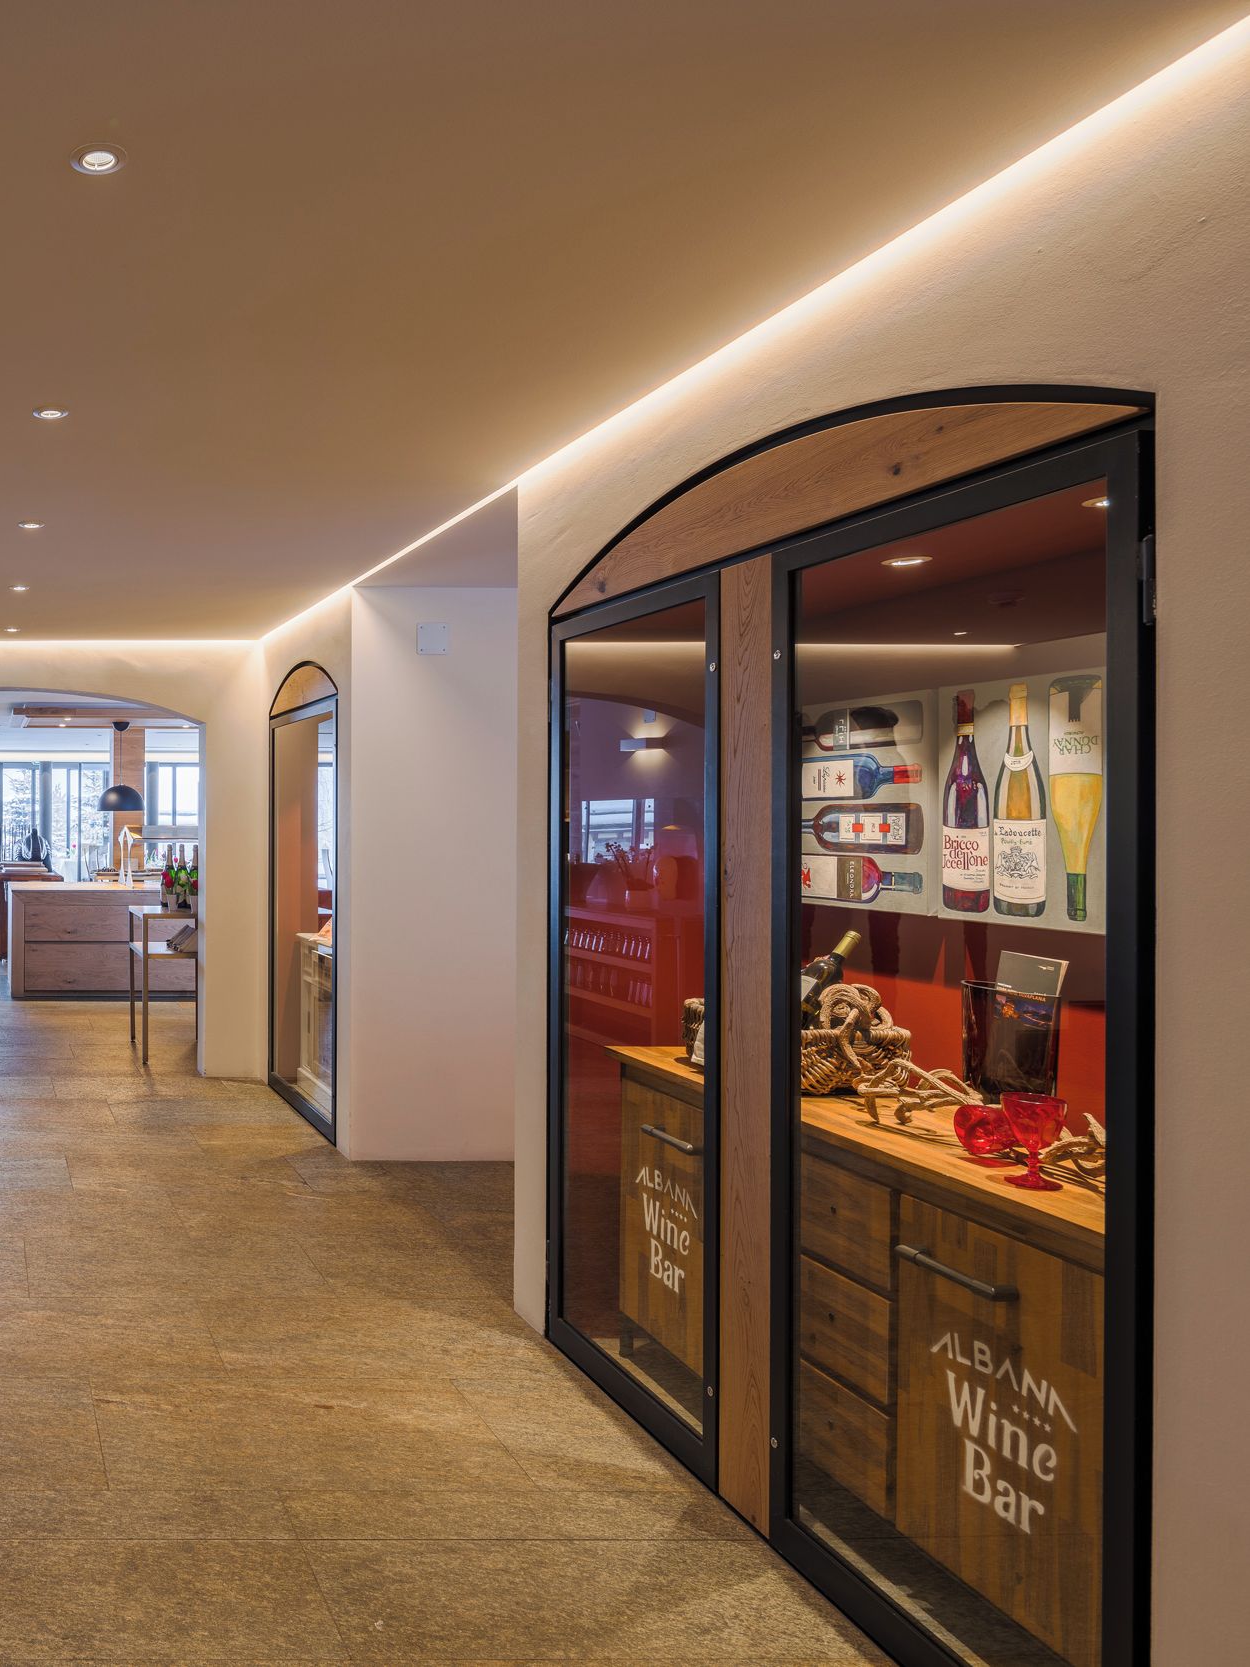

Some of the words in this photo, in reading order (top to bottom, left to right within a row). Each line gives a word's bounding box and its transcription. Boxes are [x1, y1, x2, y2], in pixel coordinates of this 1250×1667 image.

[943, 834, 980, 851] Bricco
[635, 1166, 699, 1221] ALBANA
[642, 1192, 691, 1256] Wine
[650, 1237, 685, 1294] Bar
[929, 1331, 1079, 1434] ALBANA
[946, 1368, 1058, 1483] Wine
[962, 1438, 1046, 1545] Bar
